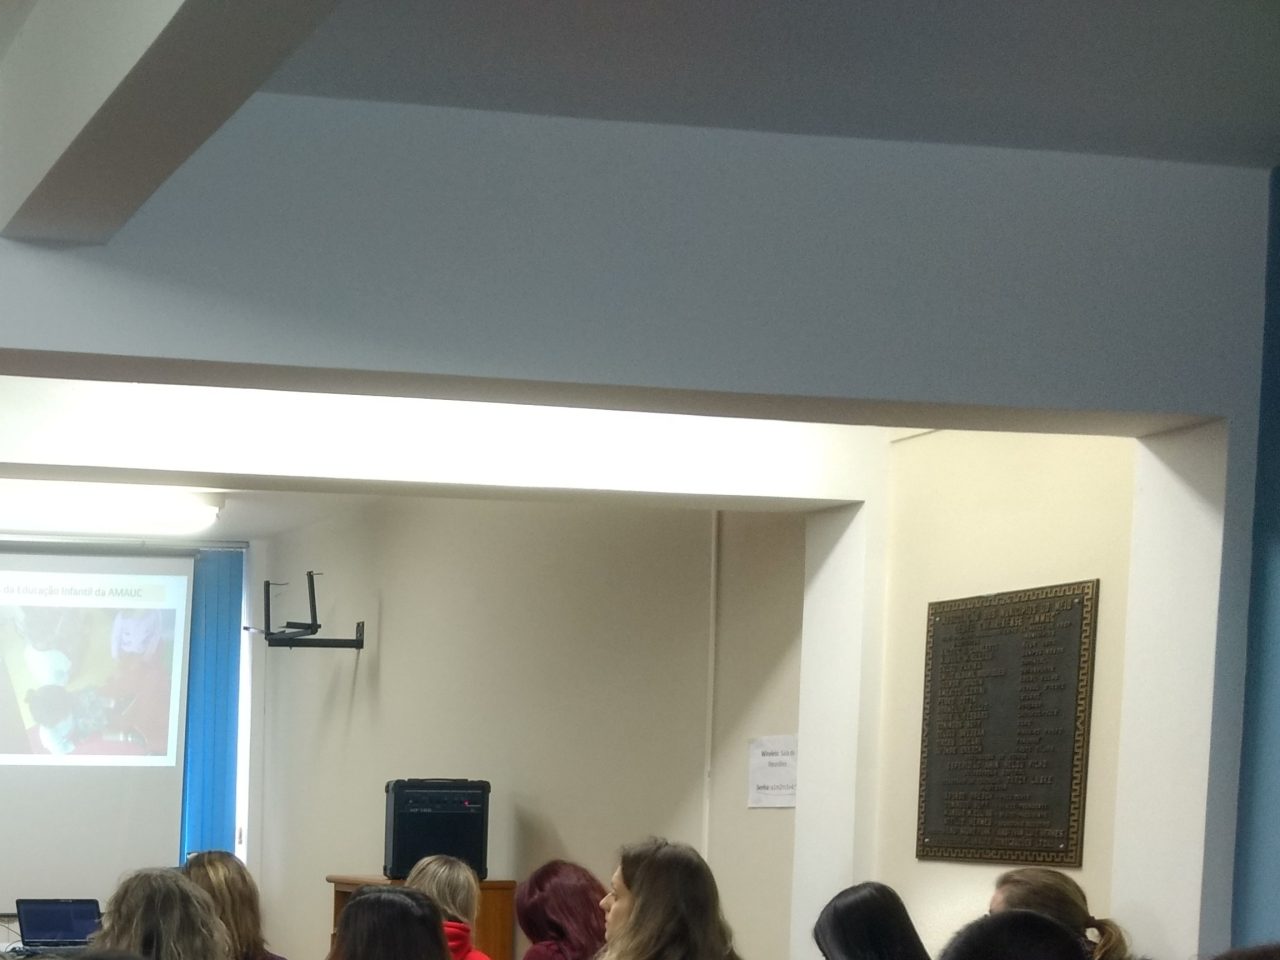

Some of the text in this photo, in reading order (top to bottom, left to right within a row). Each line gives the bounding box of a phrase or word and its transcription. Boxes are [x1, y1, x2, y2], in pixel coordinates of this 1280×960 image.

[3, 584, 15, 594] da
[61, 585, 93, 597] Infantil
[94, 587, 106, 597] da
[108, 587, 143, 598] AMAUC
